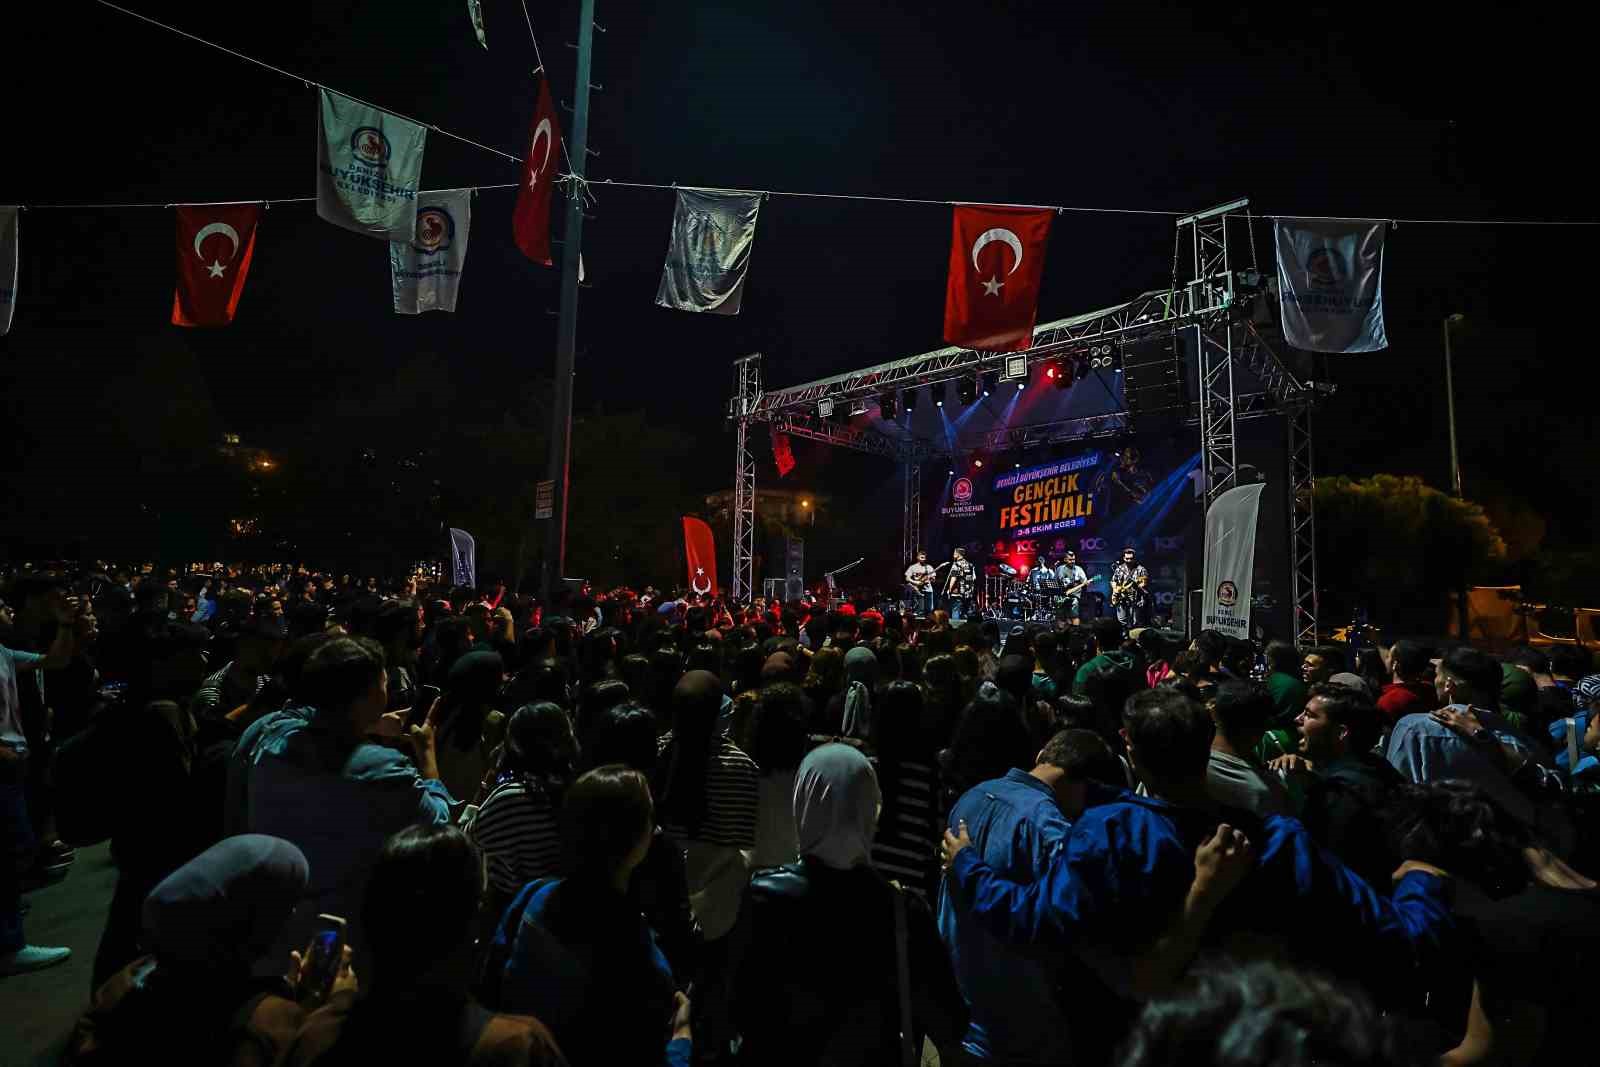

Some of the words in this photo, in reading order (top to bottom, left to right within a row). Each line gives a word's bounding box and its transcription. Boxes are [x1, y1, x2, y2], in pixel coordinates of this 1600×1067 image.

[1013, 472, 1081, 504] GENÇLİK
[999, 493, 1094, 529] FESTİVALİ
[1054, 519, 1077, 529] 2023
